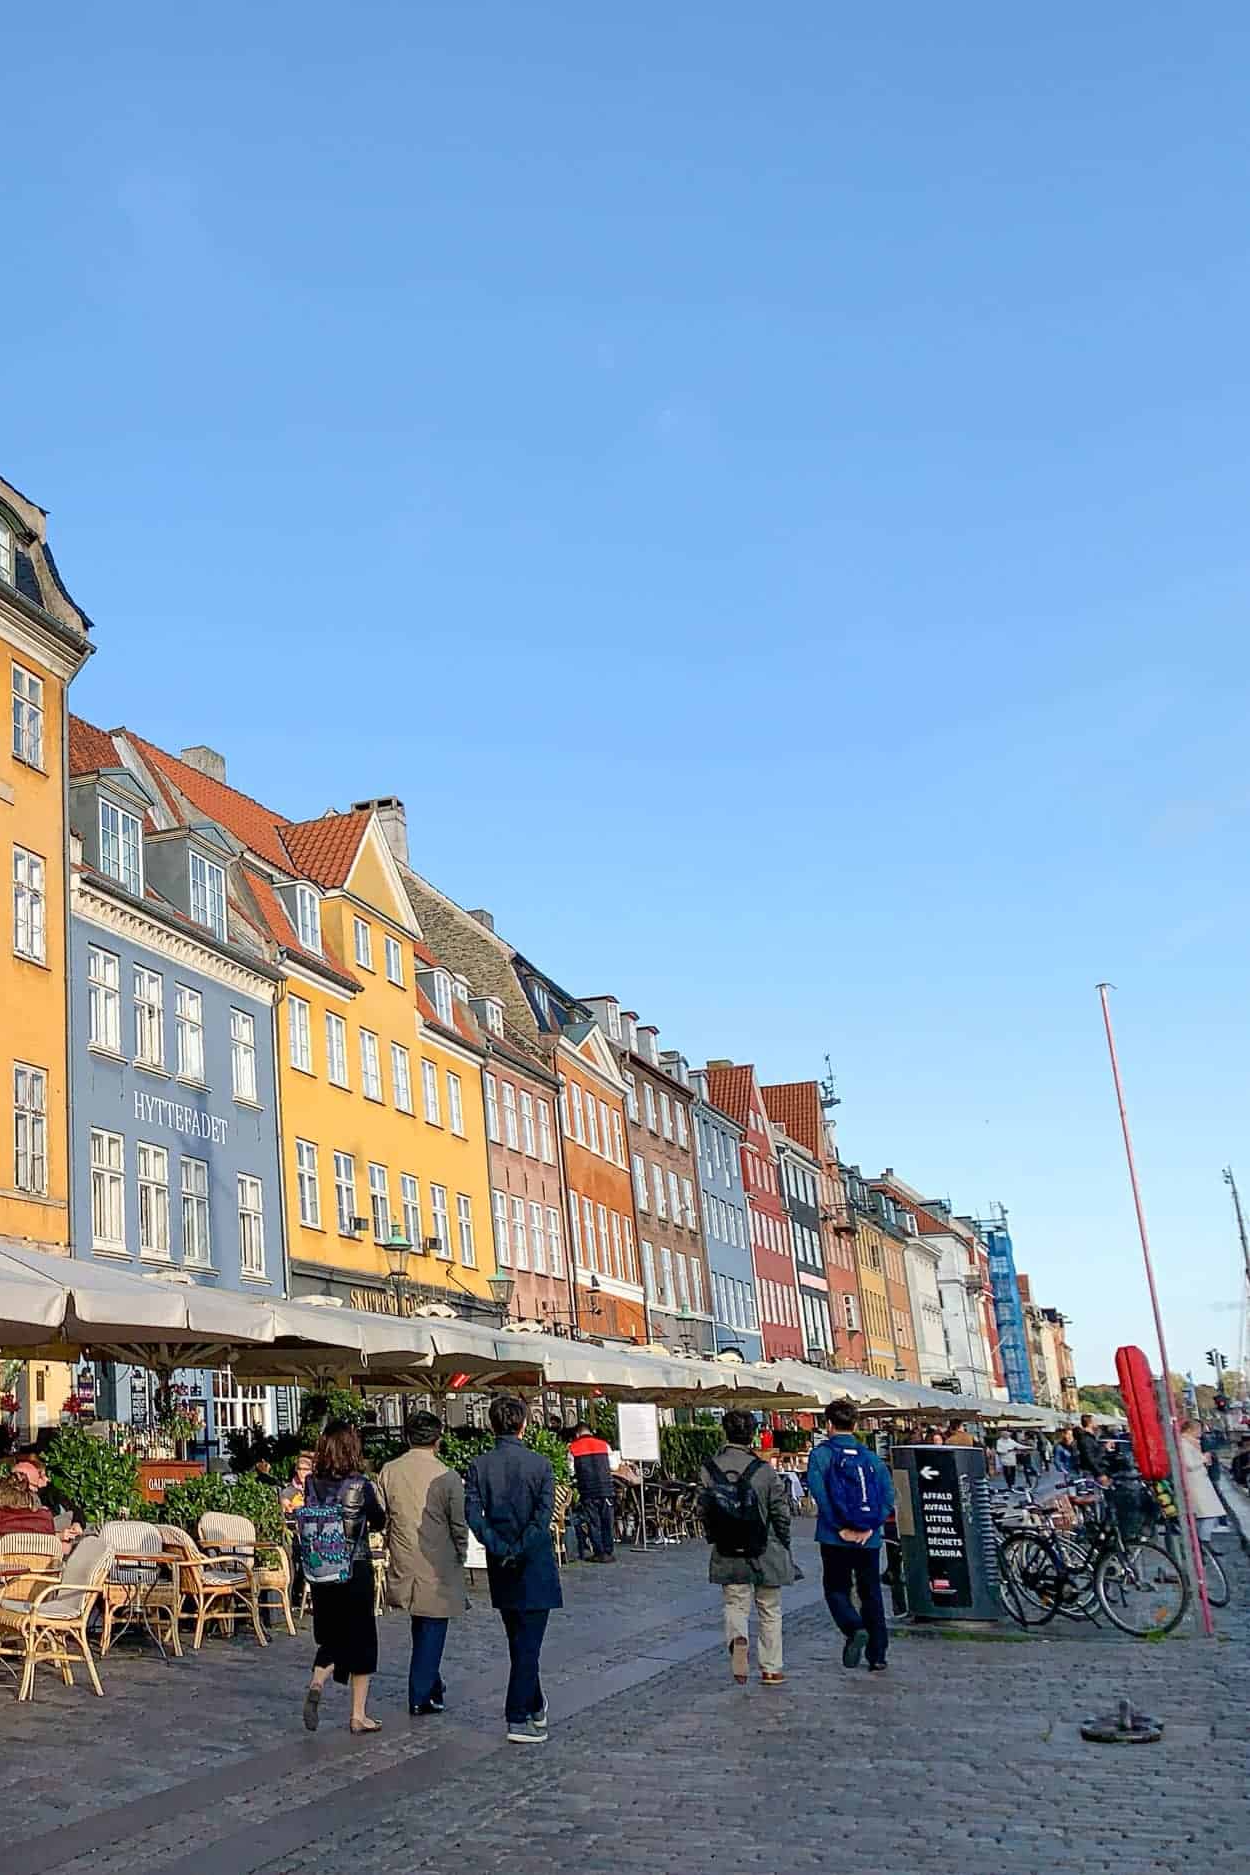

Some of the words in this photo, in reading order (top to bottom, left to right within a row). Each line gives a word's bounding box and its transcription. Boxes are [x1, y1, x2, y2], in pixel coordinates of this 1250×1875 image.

[133, 1090, 229, 1144] HYTTEFADET
[922, 1492, 952, 1500] AFFALD
[925, 1515, 952, 1523] LITTER
[929, 1549, 962, 1558] BASURA
